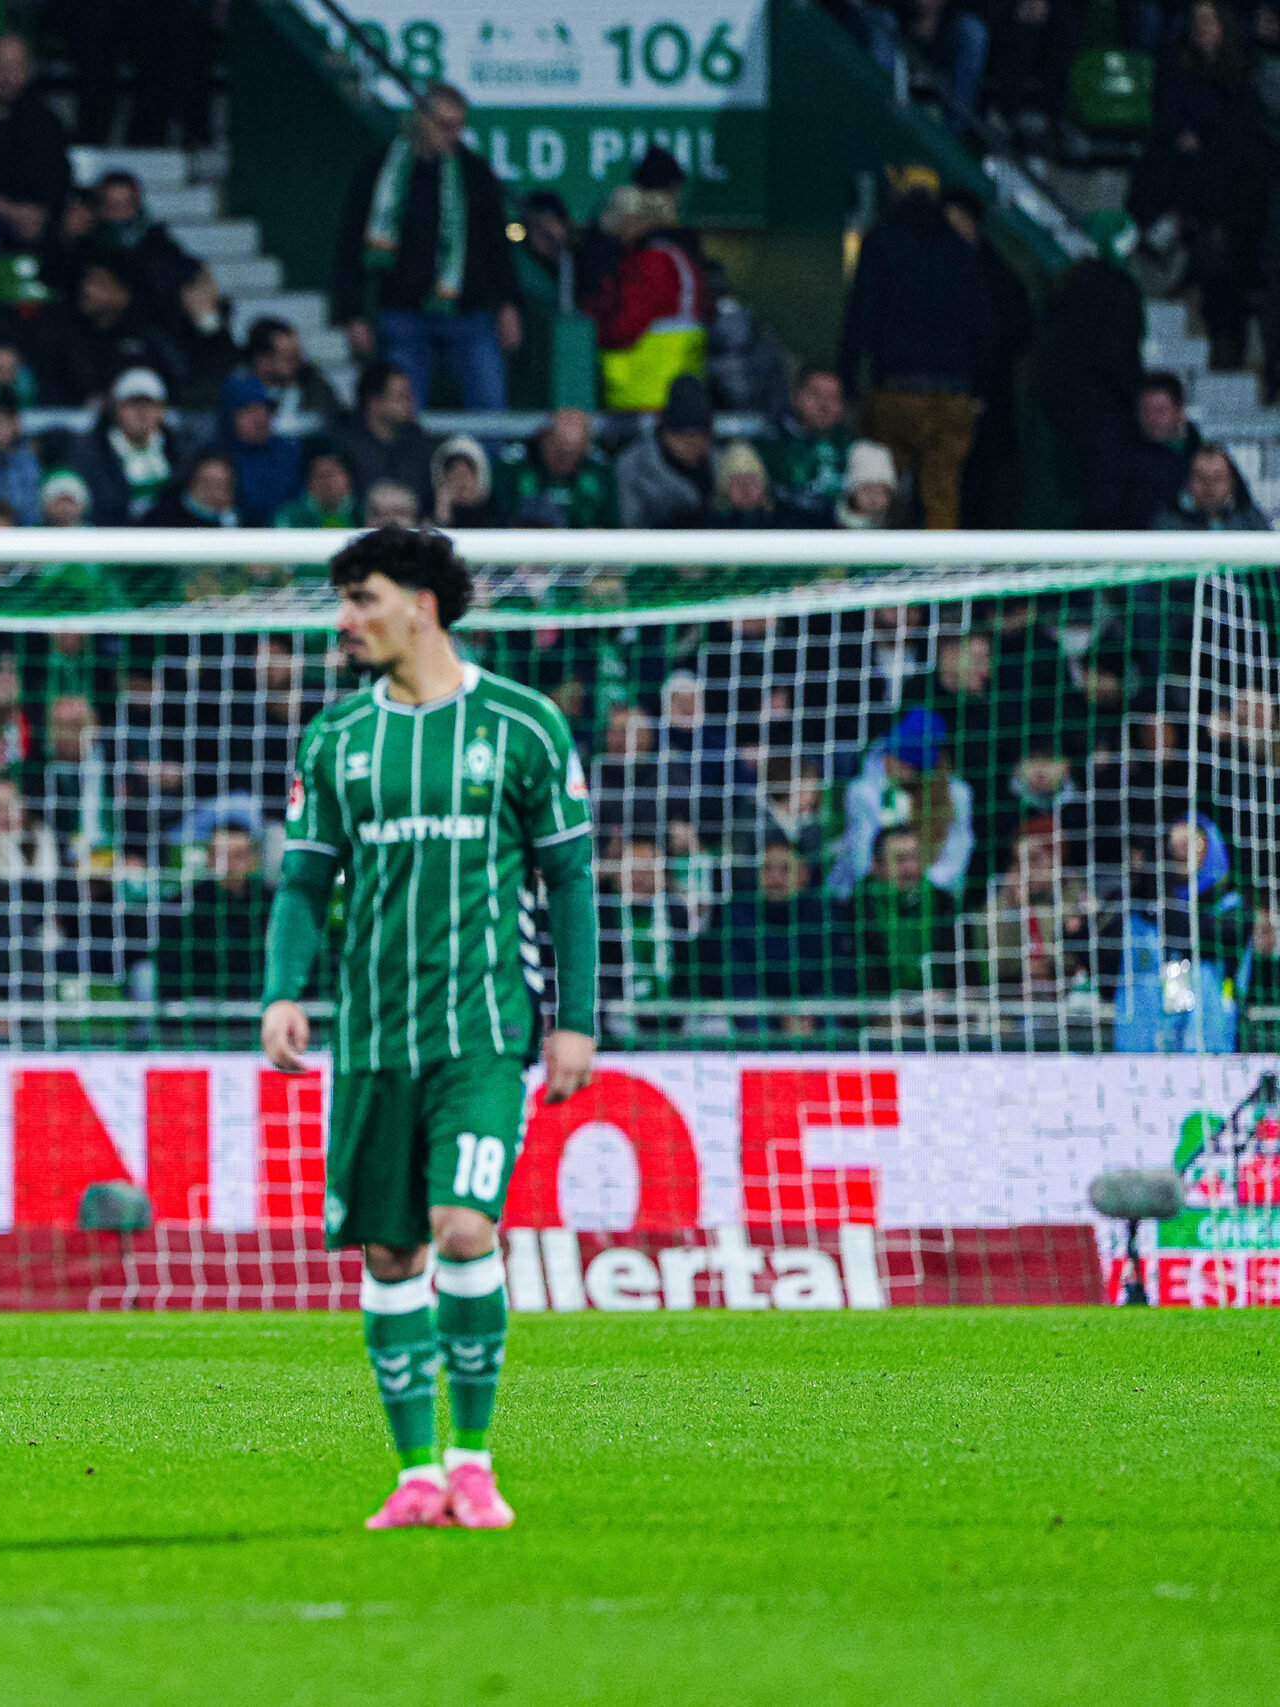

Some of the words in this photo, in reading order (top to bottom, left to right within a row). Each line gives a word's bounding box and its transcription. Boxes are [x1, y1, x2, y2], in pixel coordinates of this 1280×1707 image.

[604, 21, 743, 87] 106
[452, 1131, 506, 1203] 18
[505, 1226, 888, 1313] llertal
